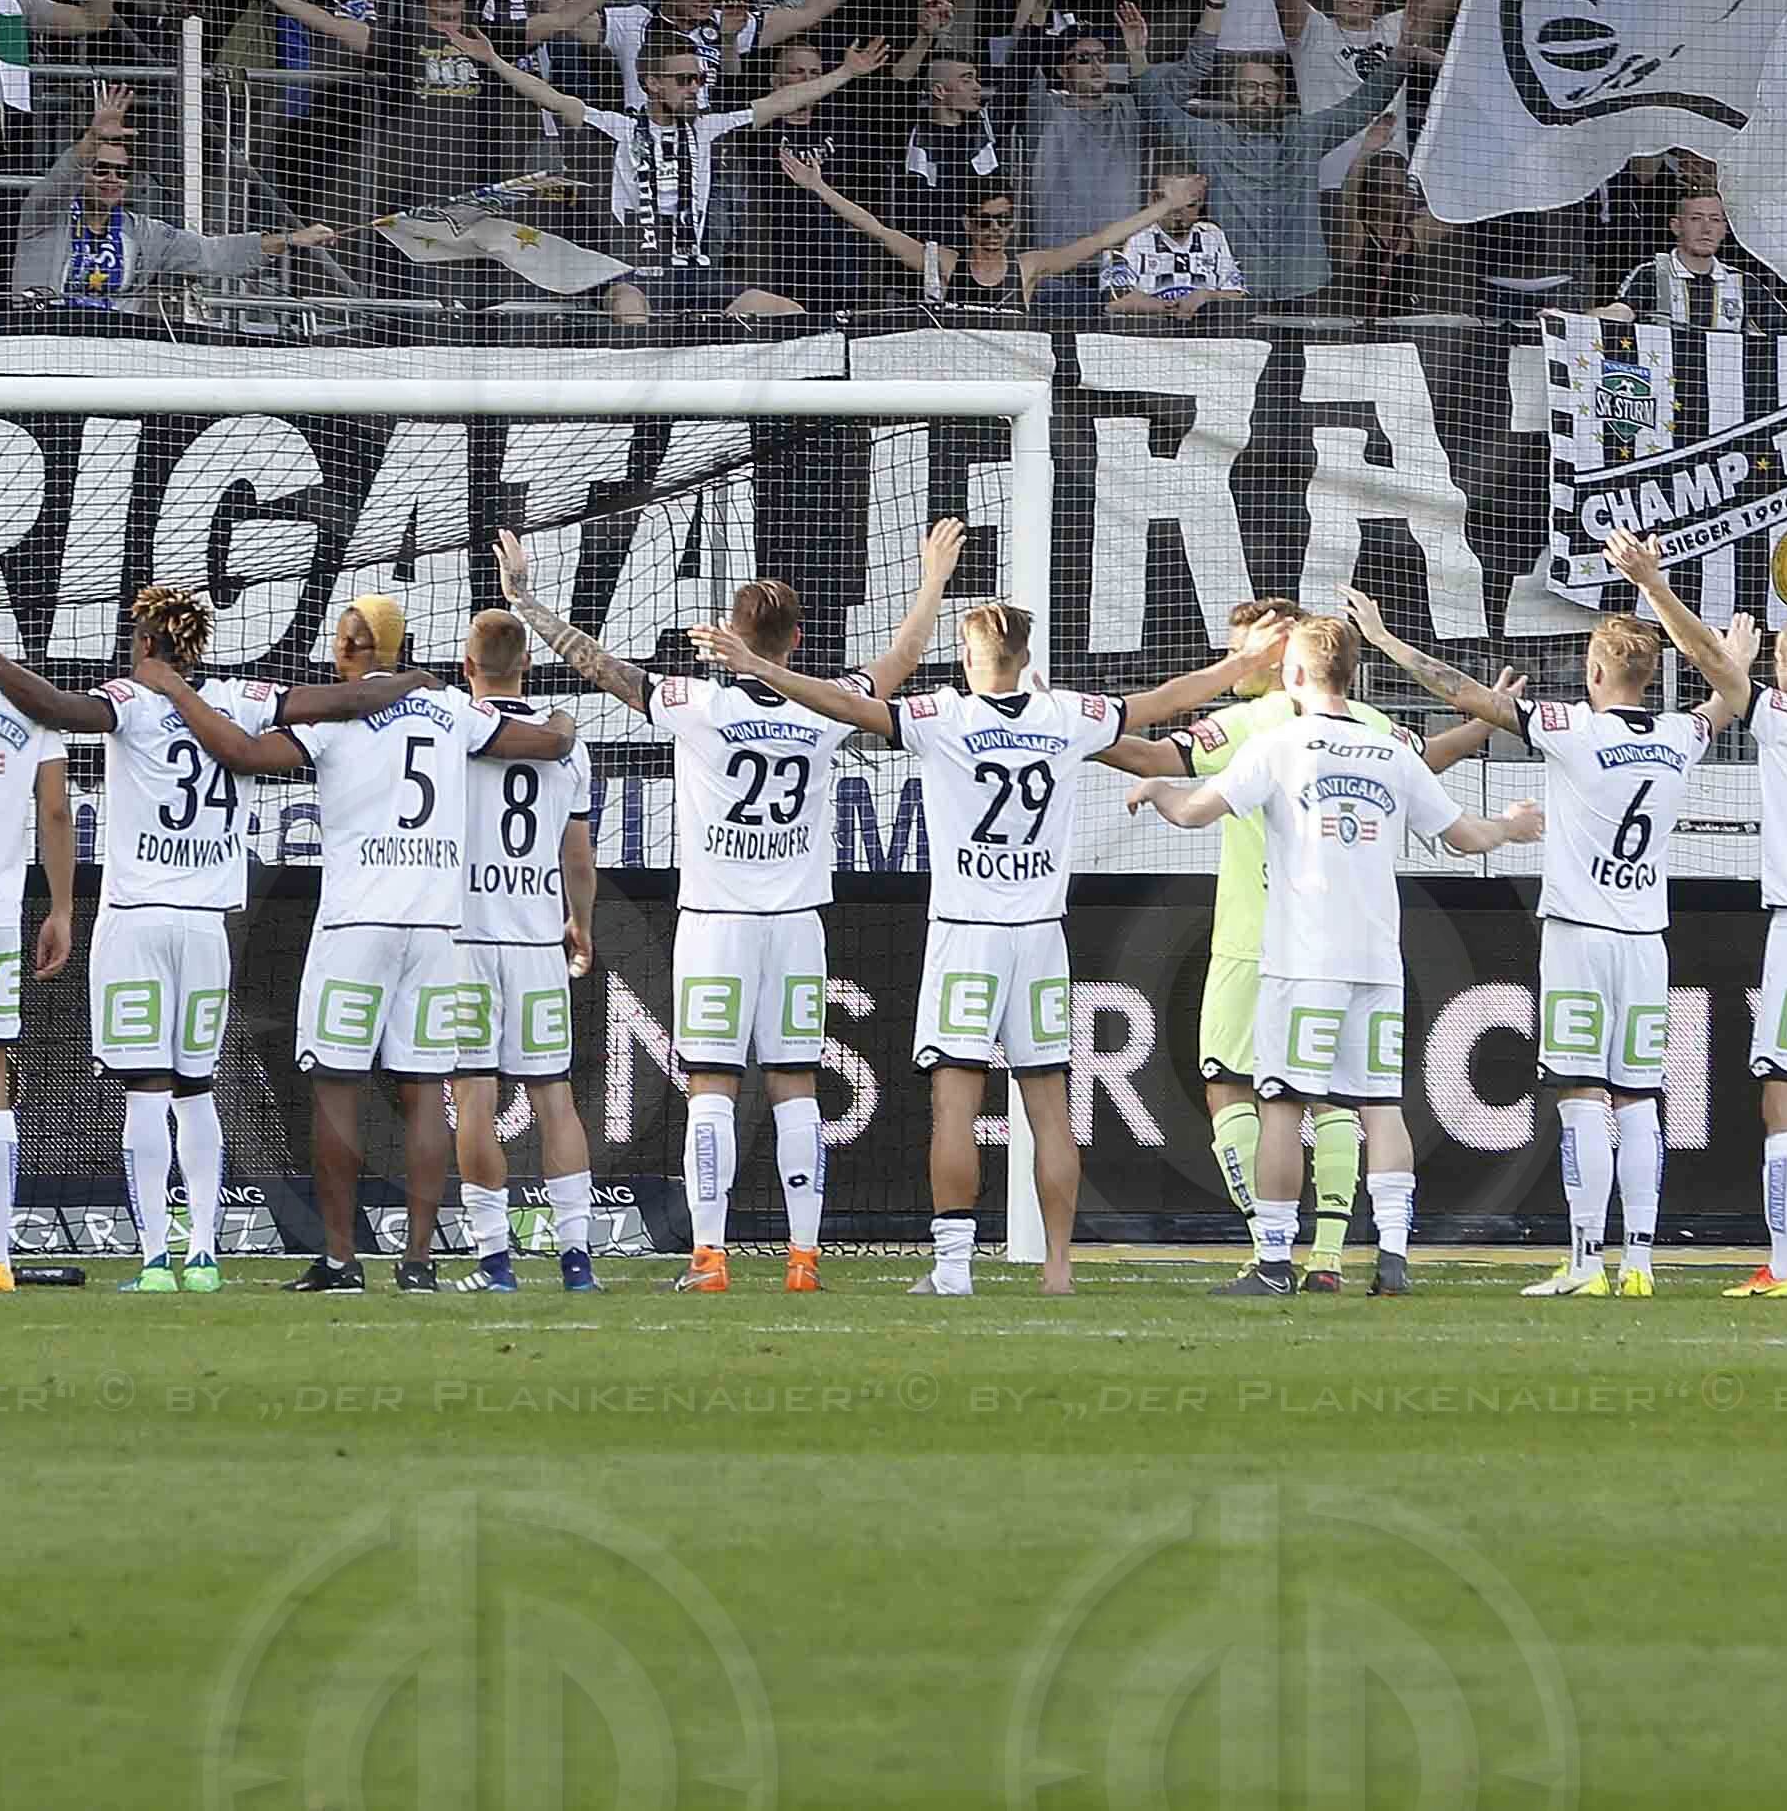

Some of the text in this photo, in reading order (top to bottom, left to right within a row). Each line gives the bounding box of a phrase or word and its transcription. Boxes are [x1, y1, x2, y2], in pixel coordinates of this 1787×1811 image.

[1581, 450, 1749, 542] CHAMP
[158, 740, 239, 833] 34
[396, 735, 437, 830] 5
[724, 749, 810, 827] 23
[1327, 743, 1395, 762] LOTTO
[500, 763, 540, 859] 8
[970, 758, 1057, 847] 29
[1612, 779, 1654, 864] 6
[469, 863, 562, 896] LOVRIC
